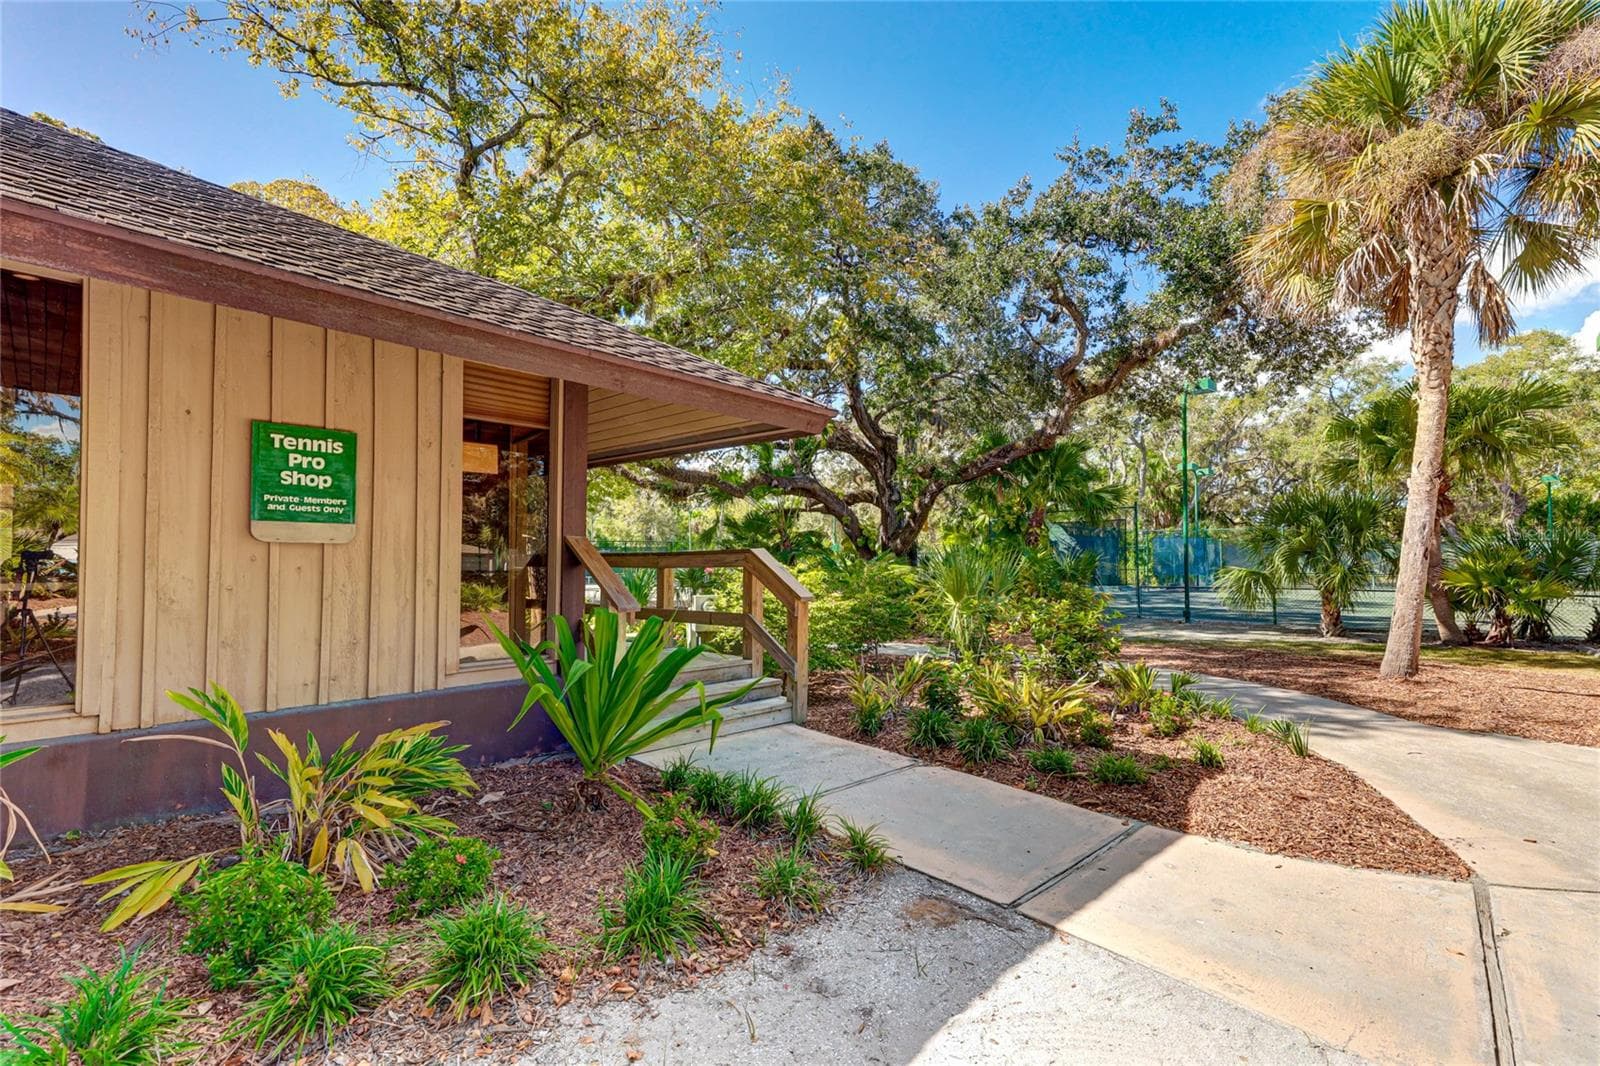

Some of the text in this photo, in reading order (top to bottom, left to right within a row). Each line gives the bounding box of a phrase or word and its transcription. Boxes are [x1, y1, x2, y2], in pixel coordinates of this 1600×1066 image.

[270, 433, 344, 454] Tennis
[288, 453, 326, 470] Pro
[280, 470, 333, 489] Shop
[263, 494, 347, 505] Private Members
[267, 503, 344, 514] and Guests Only
